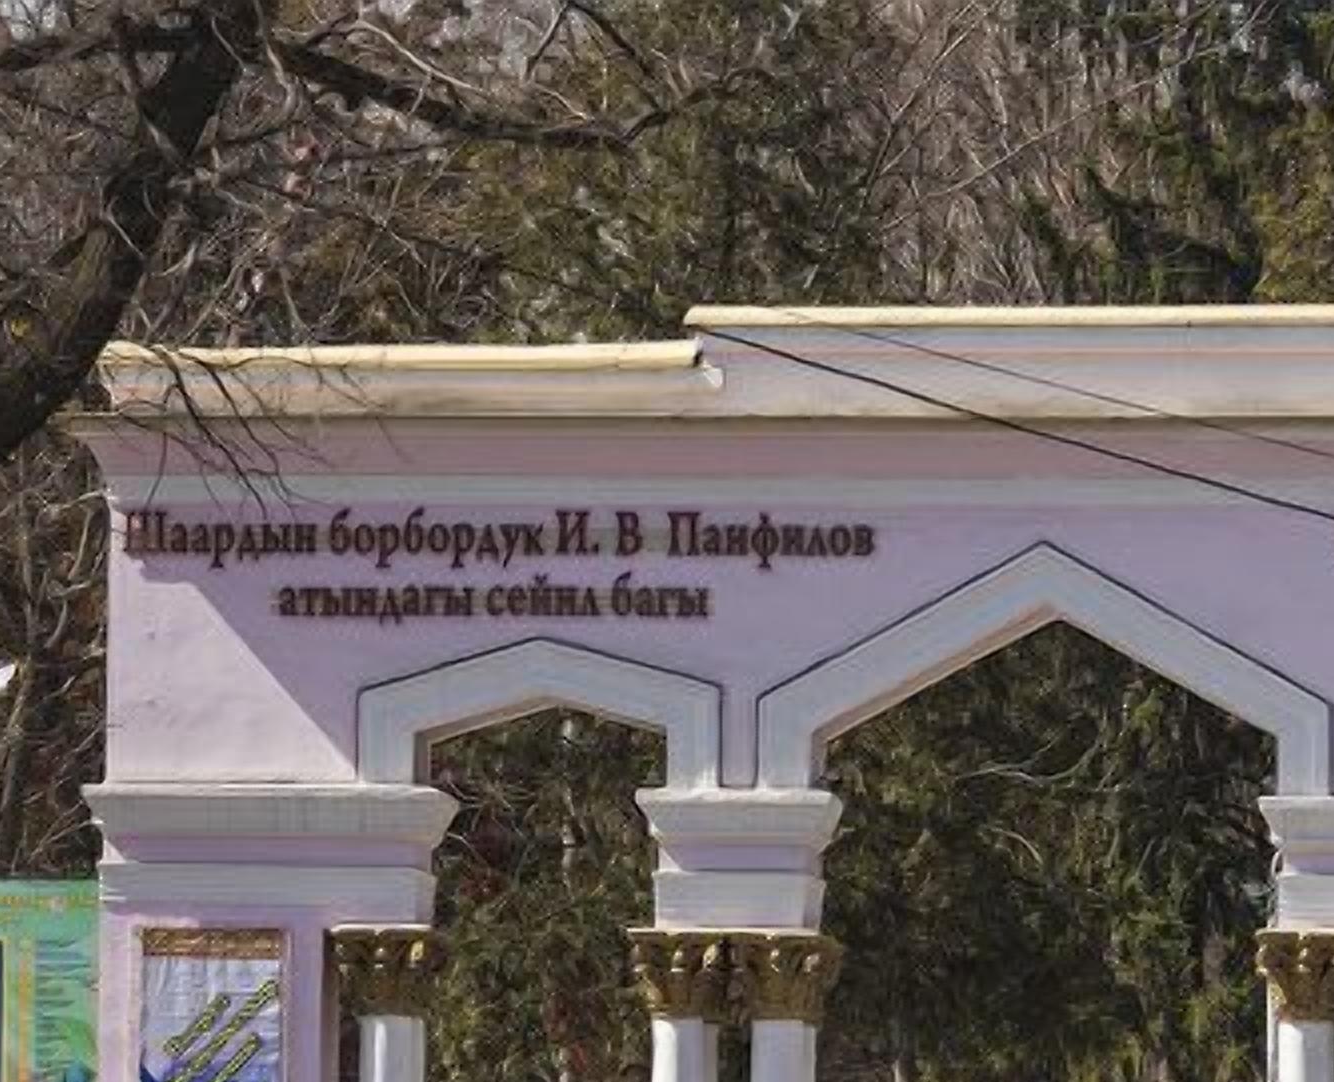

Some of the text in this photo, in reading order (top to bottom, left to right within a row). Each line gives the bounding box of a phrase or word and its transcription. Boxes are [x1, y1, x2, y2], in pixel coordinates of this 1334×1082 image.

[123, 509, 318, 568] Шаардын
[326, 508, 545, 568] борбордук
[555, 509, 600, 556] И.
[666, 509, 875, 569] Панфилов
[277, 583, 476, 622] атындагы
[609, 572, 708, 617] багы
